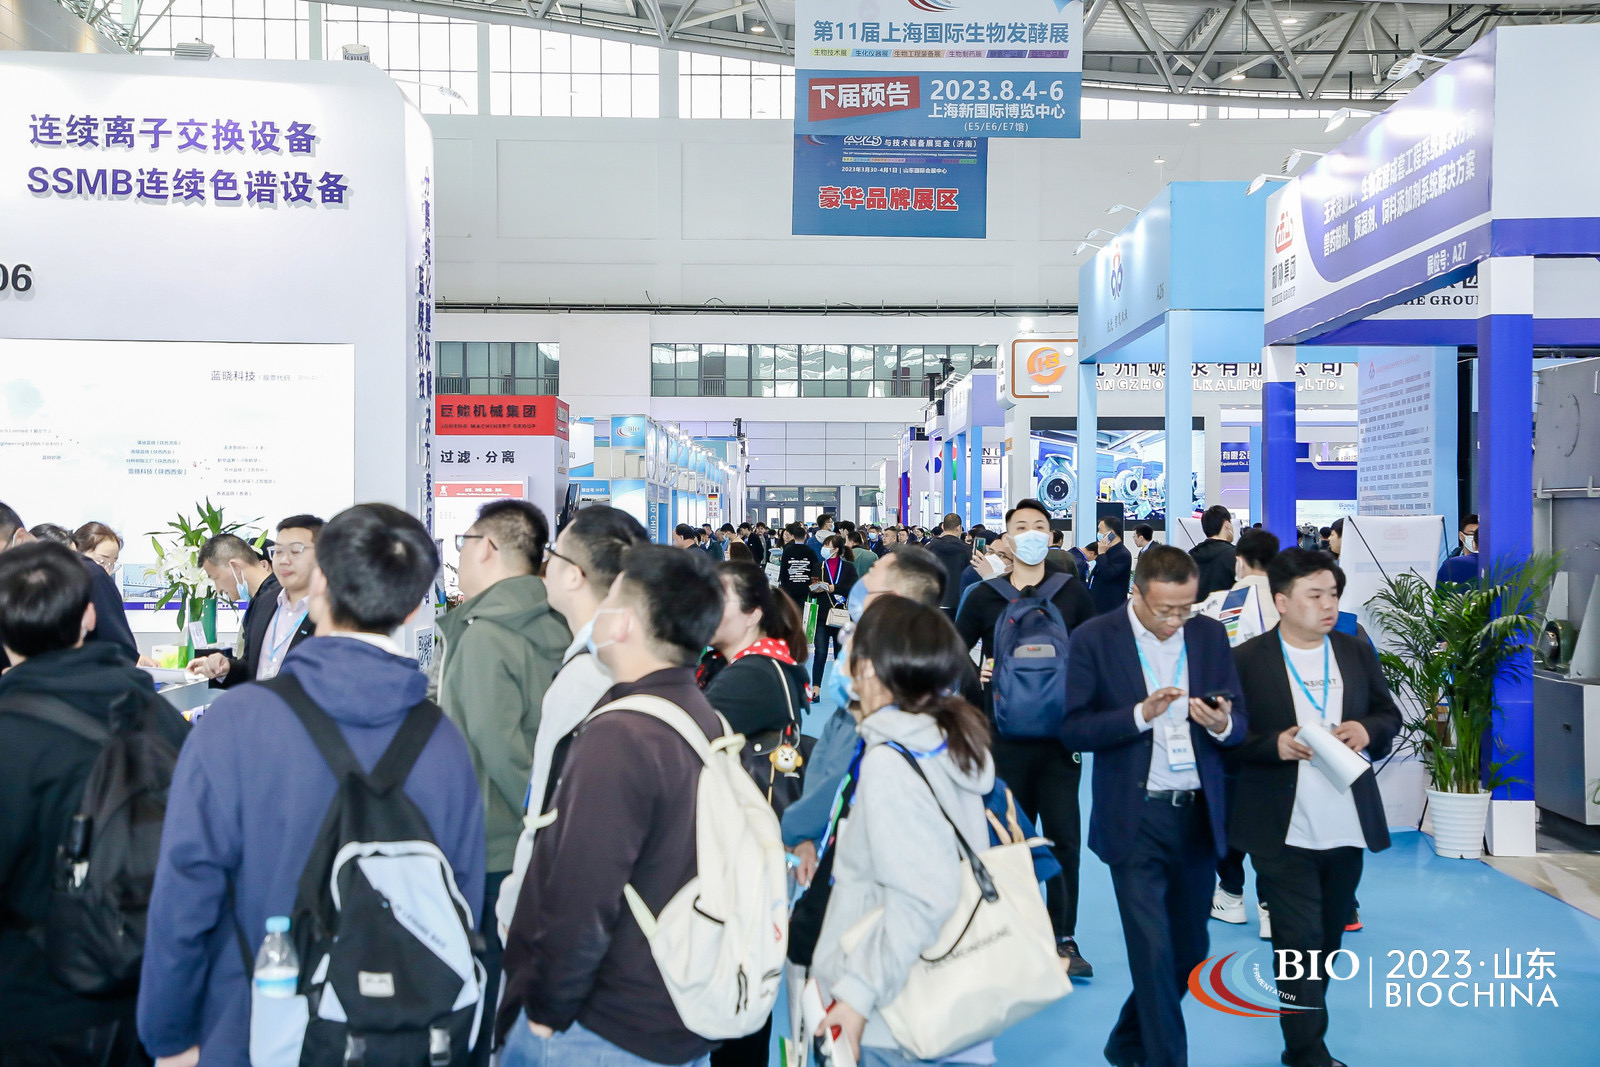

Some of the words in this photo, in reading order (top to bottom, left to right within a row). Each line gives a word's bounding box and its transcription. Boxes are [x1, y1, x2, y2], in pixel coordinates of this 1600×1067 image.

[813, 20, 1069, 43] 第11届上海国际生物发酵展
[811, 82, 911, 109] 下届预告
[930, 79, 1064, 101] 2023.8.4-6
[928, 103, 1066, 119] 上海新国际博览中心
[29, 114, 316, 153] 连续离子交换设备
[27, 167, 348, 203] SSMB连续色谱设备
[819, 185, 960, 211] 豪华品牌展区
[1096, 379, 1165, 391] ANGZHO
[1193, 379, 1263, 391] LKALIPU
[441, 404, 536, 418] 巨能机械集团
[440, 450, 515, 464] 过滤·分离
[1220, 450, 1249, 460] 有限公
